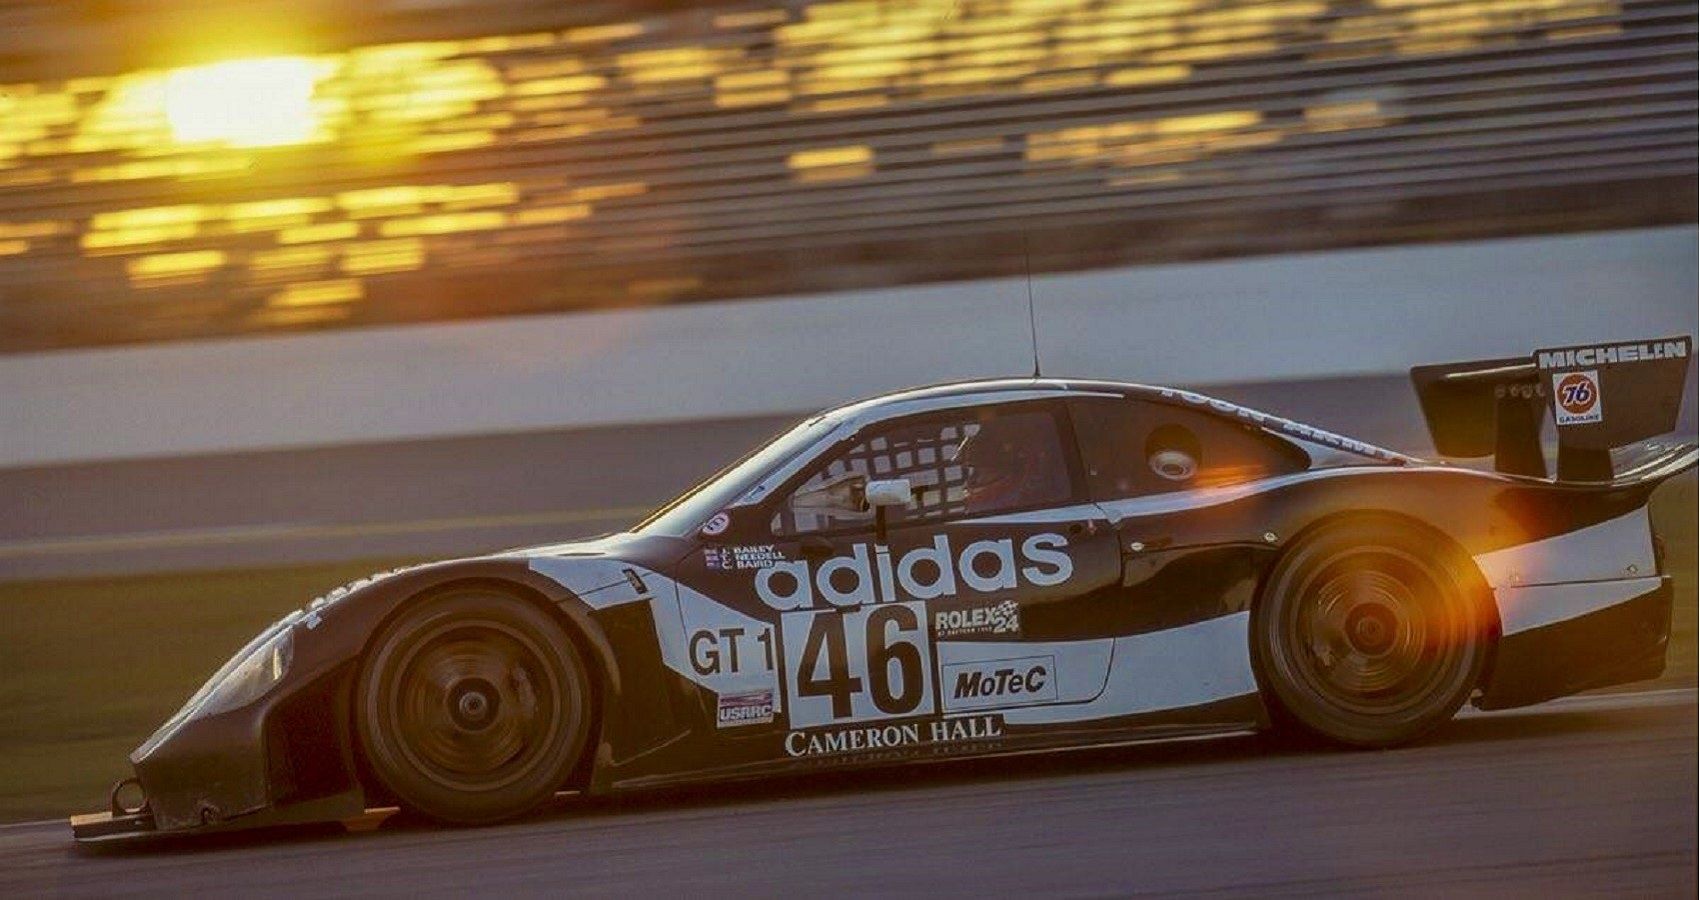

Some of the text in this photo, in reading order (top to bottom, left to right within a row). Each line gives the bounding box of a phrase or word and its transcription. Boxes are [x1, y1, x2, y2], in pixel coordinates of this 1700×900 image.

[1538, 341, 1687, 369] MICHELIN
[1563, 380, 1592, 406] 76
[734, 544, 775, 554] BAILEY
[735, 551, 786, 561] NEEDELL
[736, 560, 774, 570] BAIRD
[754, 532, 1074, 611] adidas
[935, 607, 997, 630] ROLEX
[993, 615, 1020, 634] 24
[689, 626, 775, 676] GT 1
[797, 602, 925, 720] 46
[953, 665, 1047, 700] MoTeC
[719, 704, 772, 721] USRRC
[784, 722, 919, 757] CAMERON
[929, 716, 1002, 742] HALL
